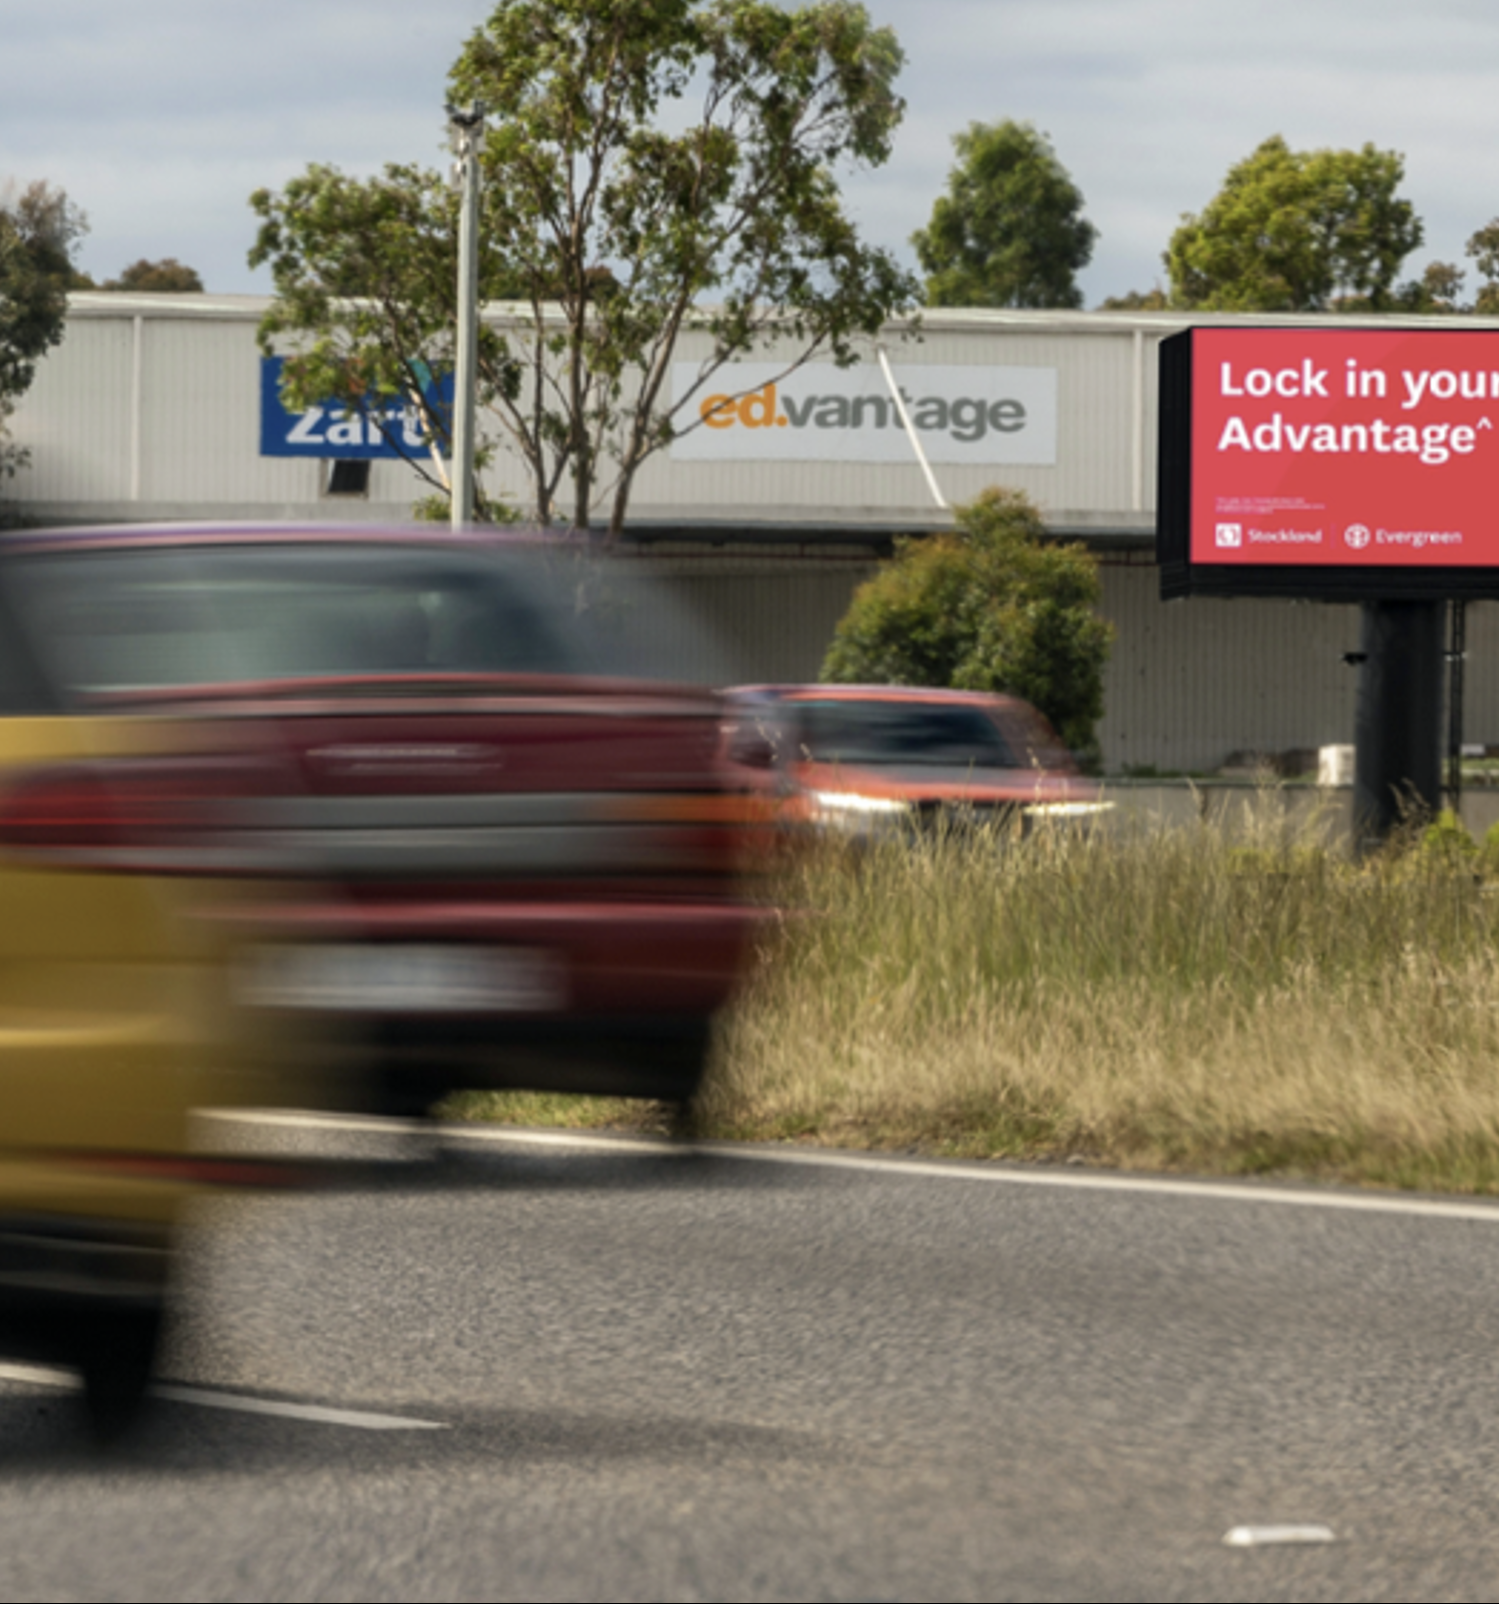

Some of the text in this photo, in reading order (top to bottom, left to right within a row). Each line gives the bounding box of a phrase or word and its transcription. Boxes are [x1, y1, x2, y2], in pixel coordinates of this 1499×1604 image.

[1221, 358, 1329, 397] Lock
[1346, 358, 1386, 397] in
[699, 382, 1026, 442] ed.vantage
[1247, 528, 1323, 544] Stockland
[1375, 529, 1462, 548] Evergreen
